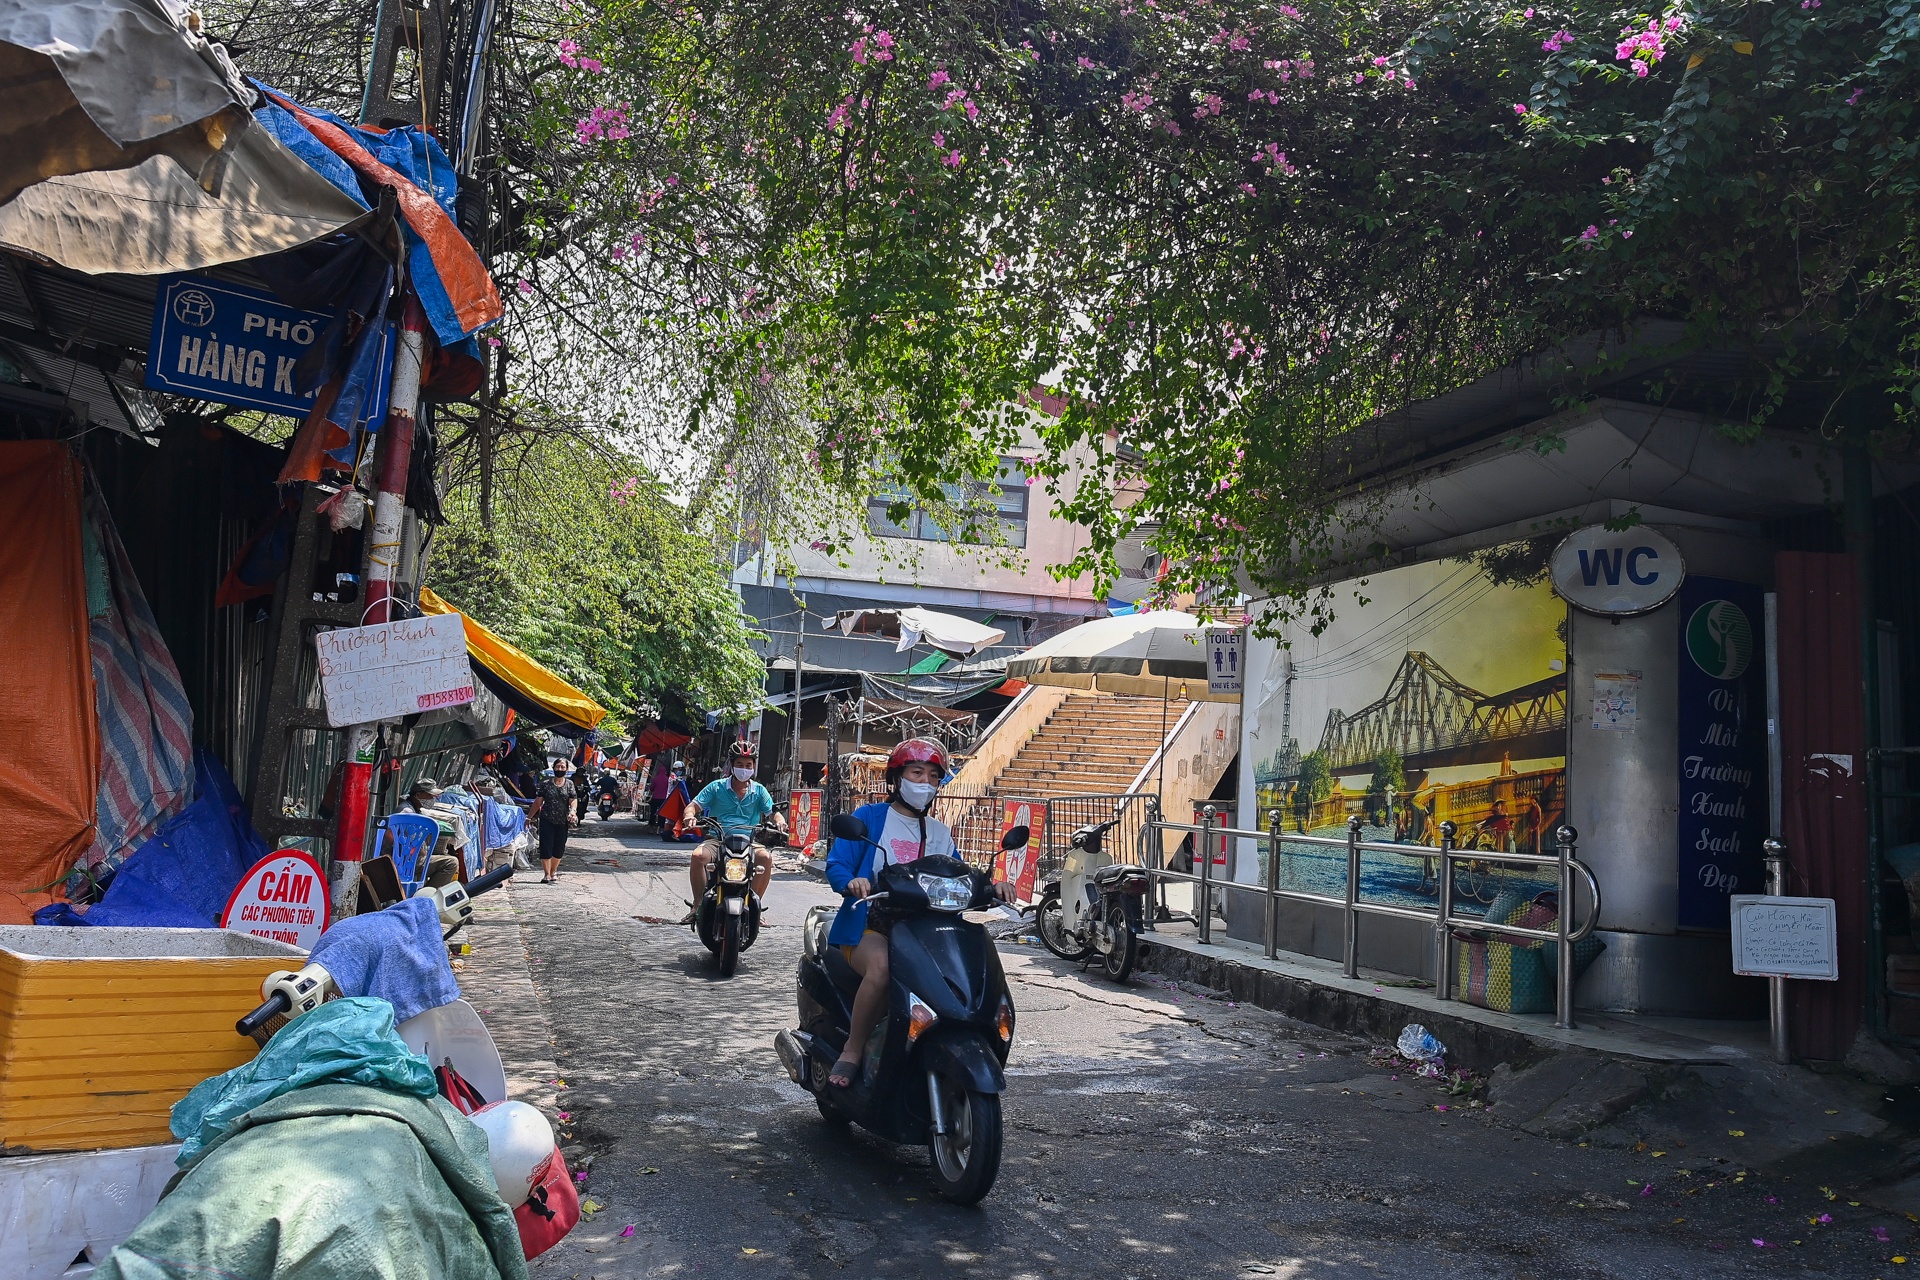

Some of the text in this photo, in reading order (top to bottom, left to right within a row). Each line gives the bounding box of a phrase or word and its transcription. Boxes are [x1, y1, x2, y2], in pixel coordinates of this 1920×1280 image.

[243, 312, 318, 345] PHỐ
[178, 332, 266, 389] HÀNG
[1578, 546, 1659, 586] WC
[1210, 635, 1241, 644] TOILET
[1699, 722, 1738, 748] Môi
[1683, 755, 1752, 789] Trường
[1691, 791, 1746, 819] Xanh
[1695, 827, 1741, 856] Sạch
[258, 863, 313, 904] CẤM
[1698, 863, 1739, 894] Đẹp
[241, 902, 316, 928] CÁC PHƯƠNG TIỆN
